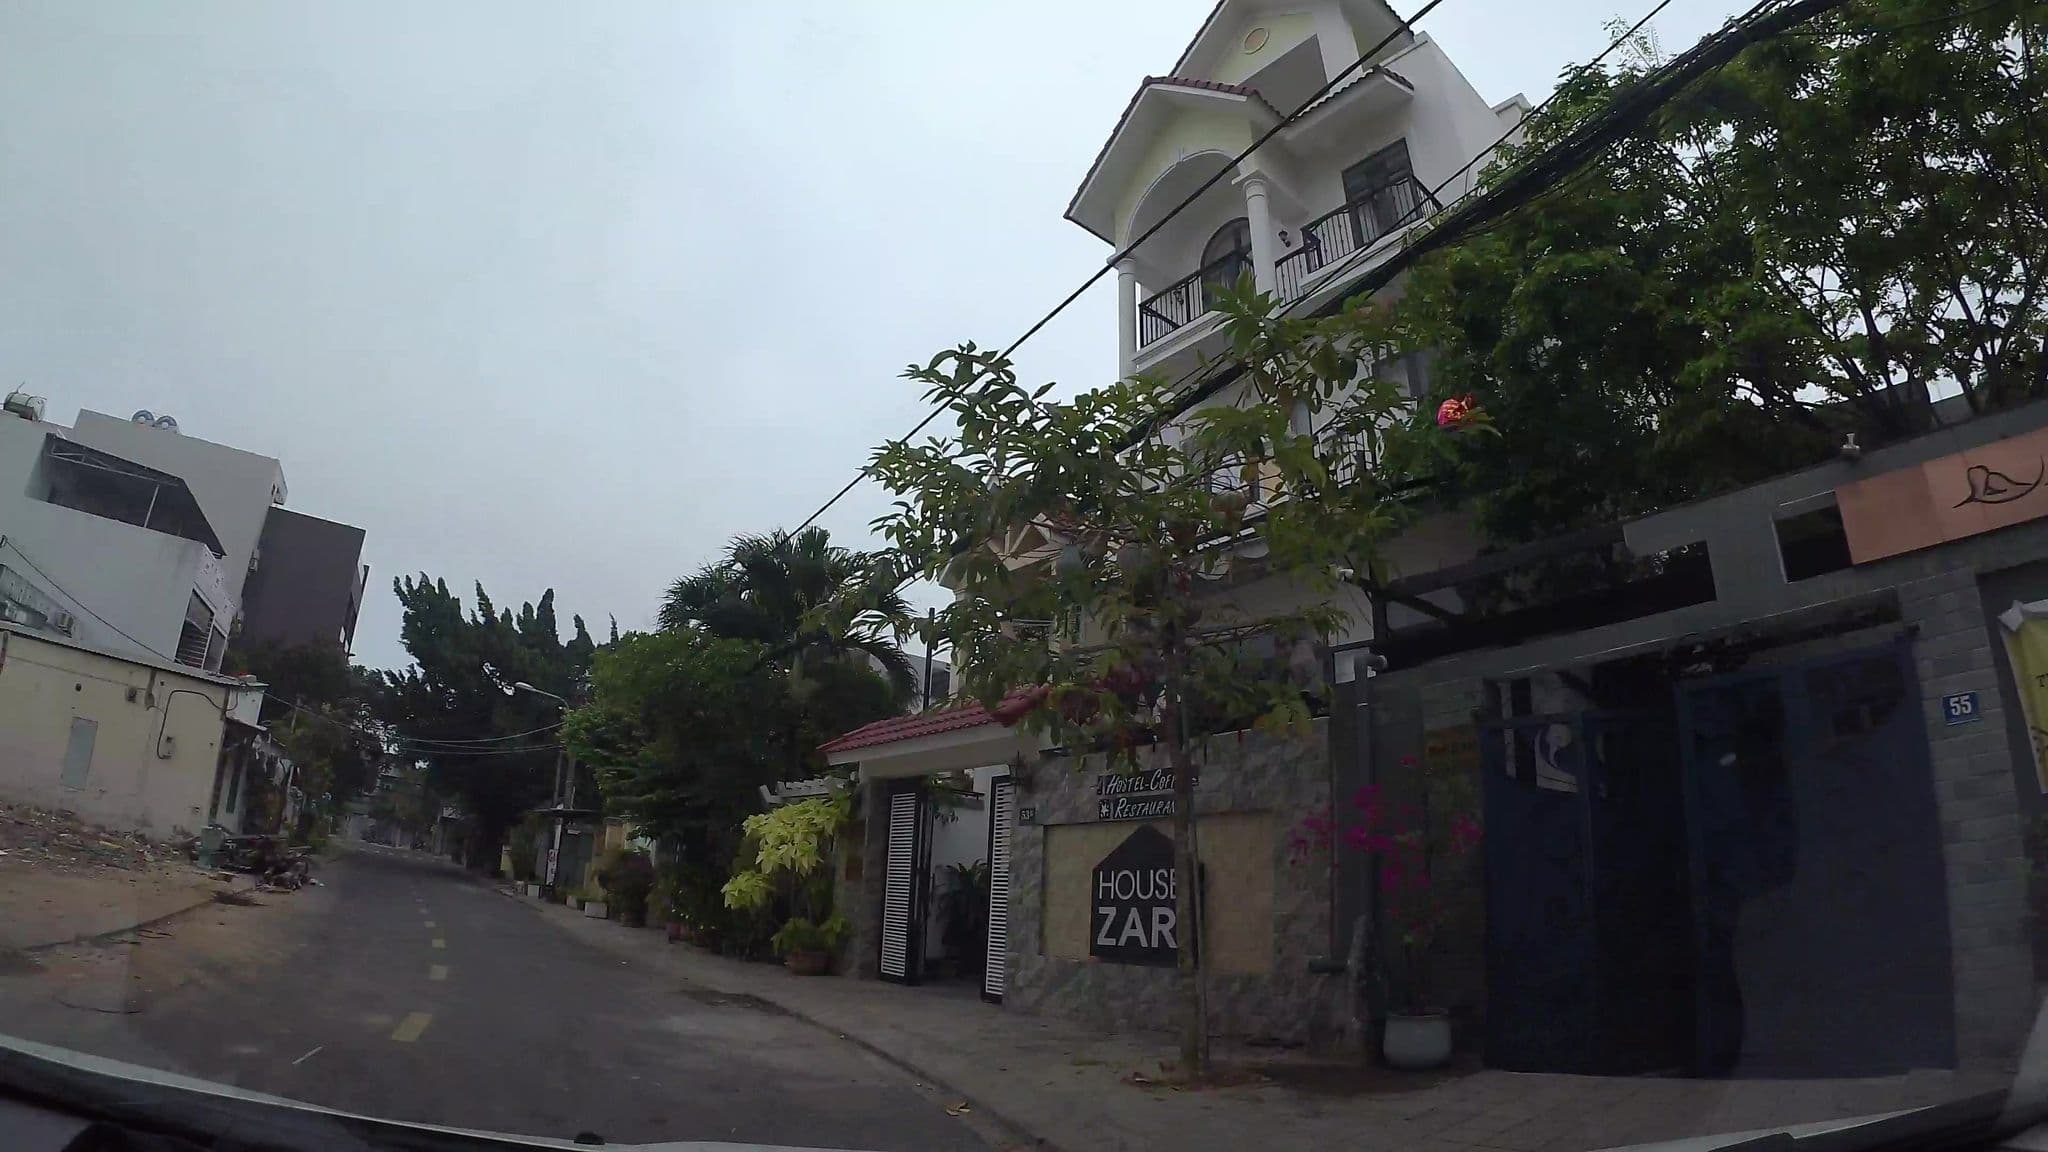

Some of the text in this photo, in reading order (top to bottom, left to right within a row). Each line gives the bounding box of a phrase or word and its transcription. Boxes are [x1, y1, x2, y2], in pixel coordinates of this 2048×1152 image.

[1949, 695, 1972, 715] 55
[1099, 868, 1177, 899] HOUSE
[1097, 906, 1178, 948] ZAR
